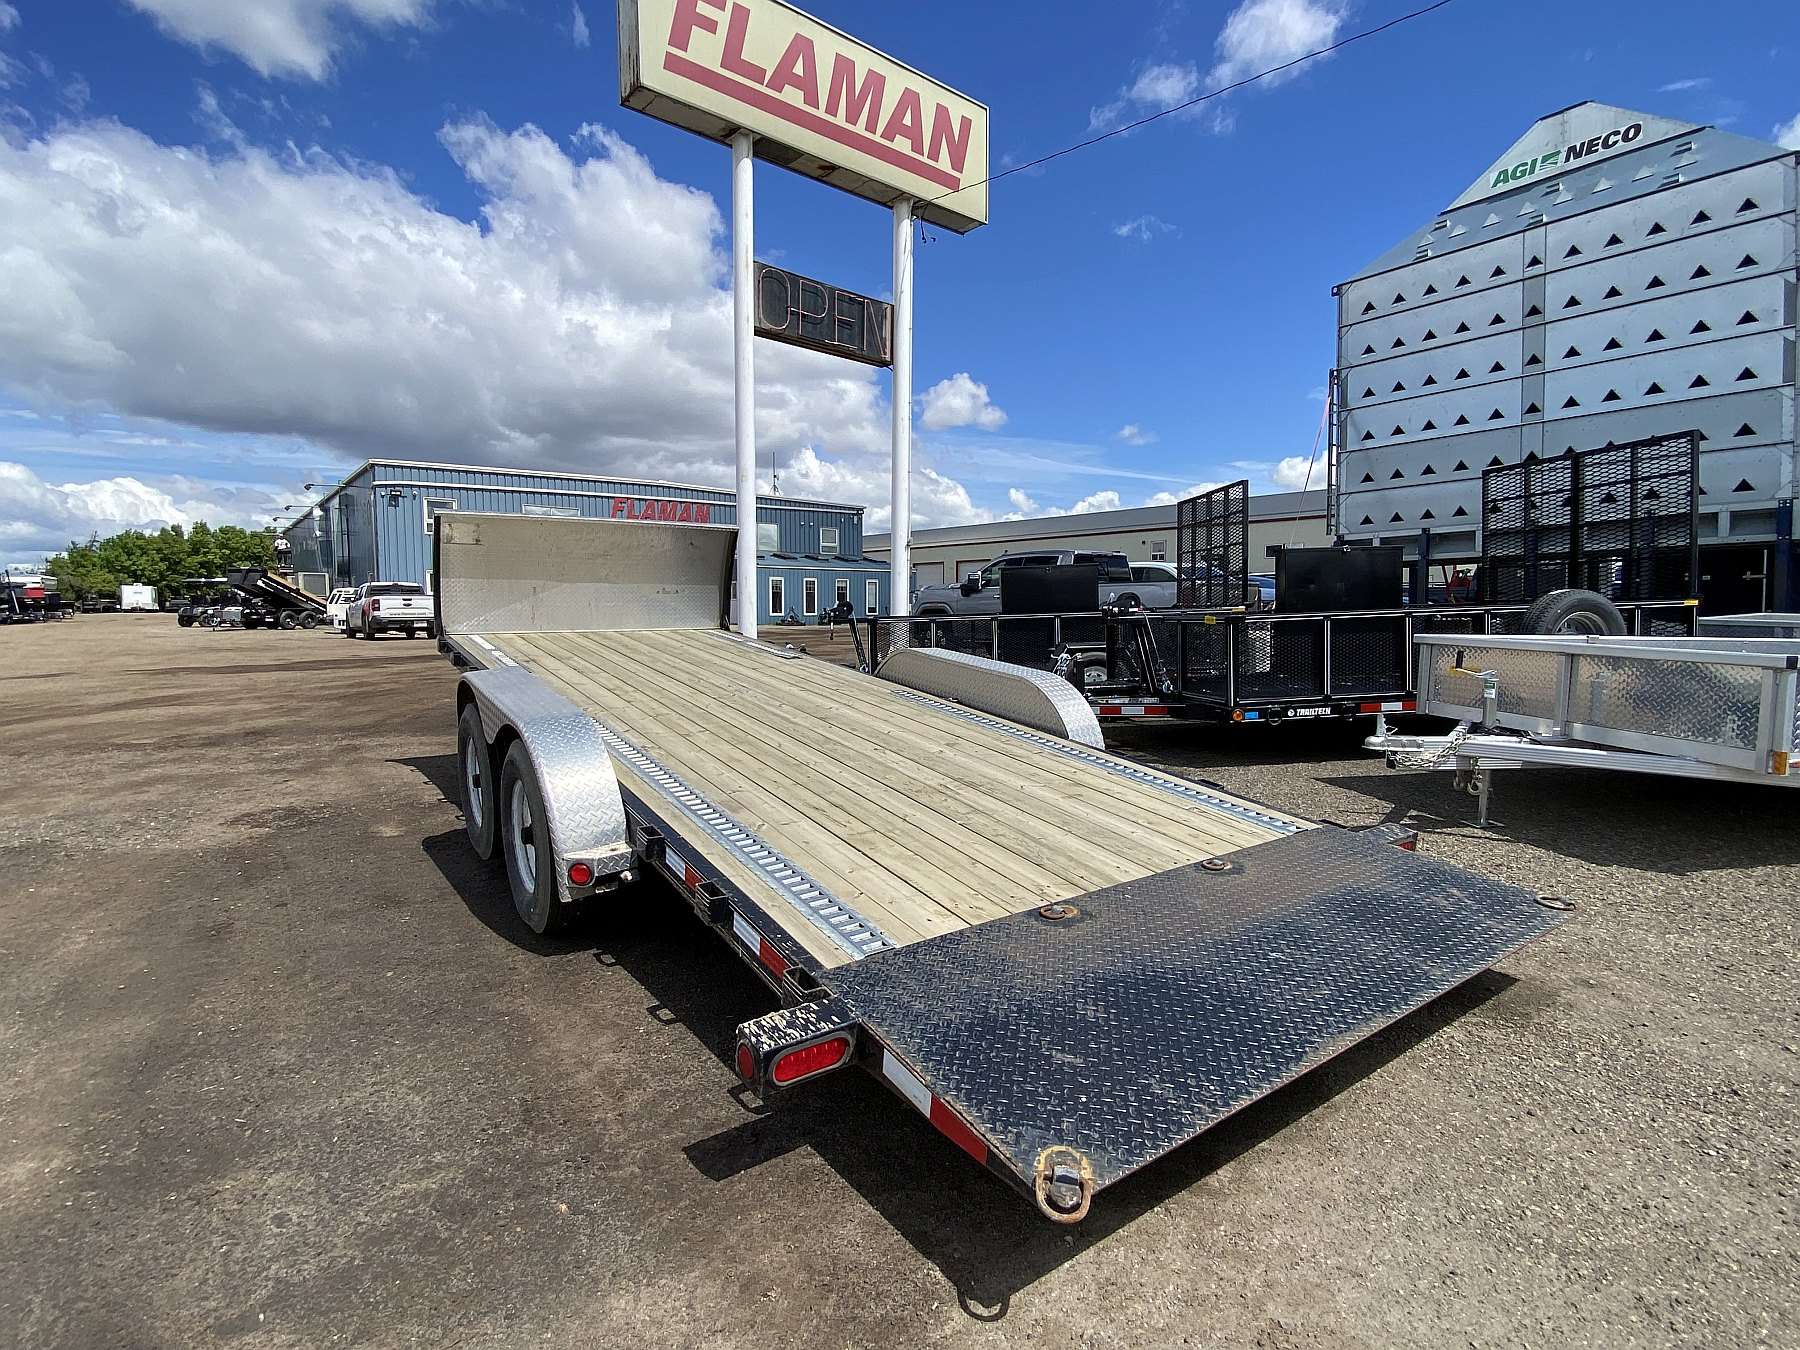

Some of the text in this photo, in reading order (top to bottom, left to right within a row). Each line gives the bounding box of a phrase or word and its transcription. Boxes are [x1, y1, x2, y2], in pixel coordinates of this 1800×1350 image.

[668, 0, 972, 174] FLAMAN
[1490, 123, 1642, 188] AGI NECO
[759, 267, 889, 358] OPEN
[610, 497, 711, 523] FLAMAN
[1296, 707, 1331, 717] TRAILTECH
